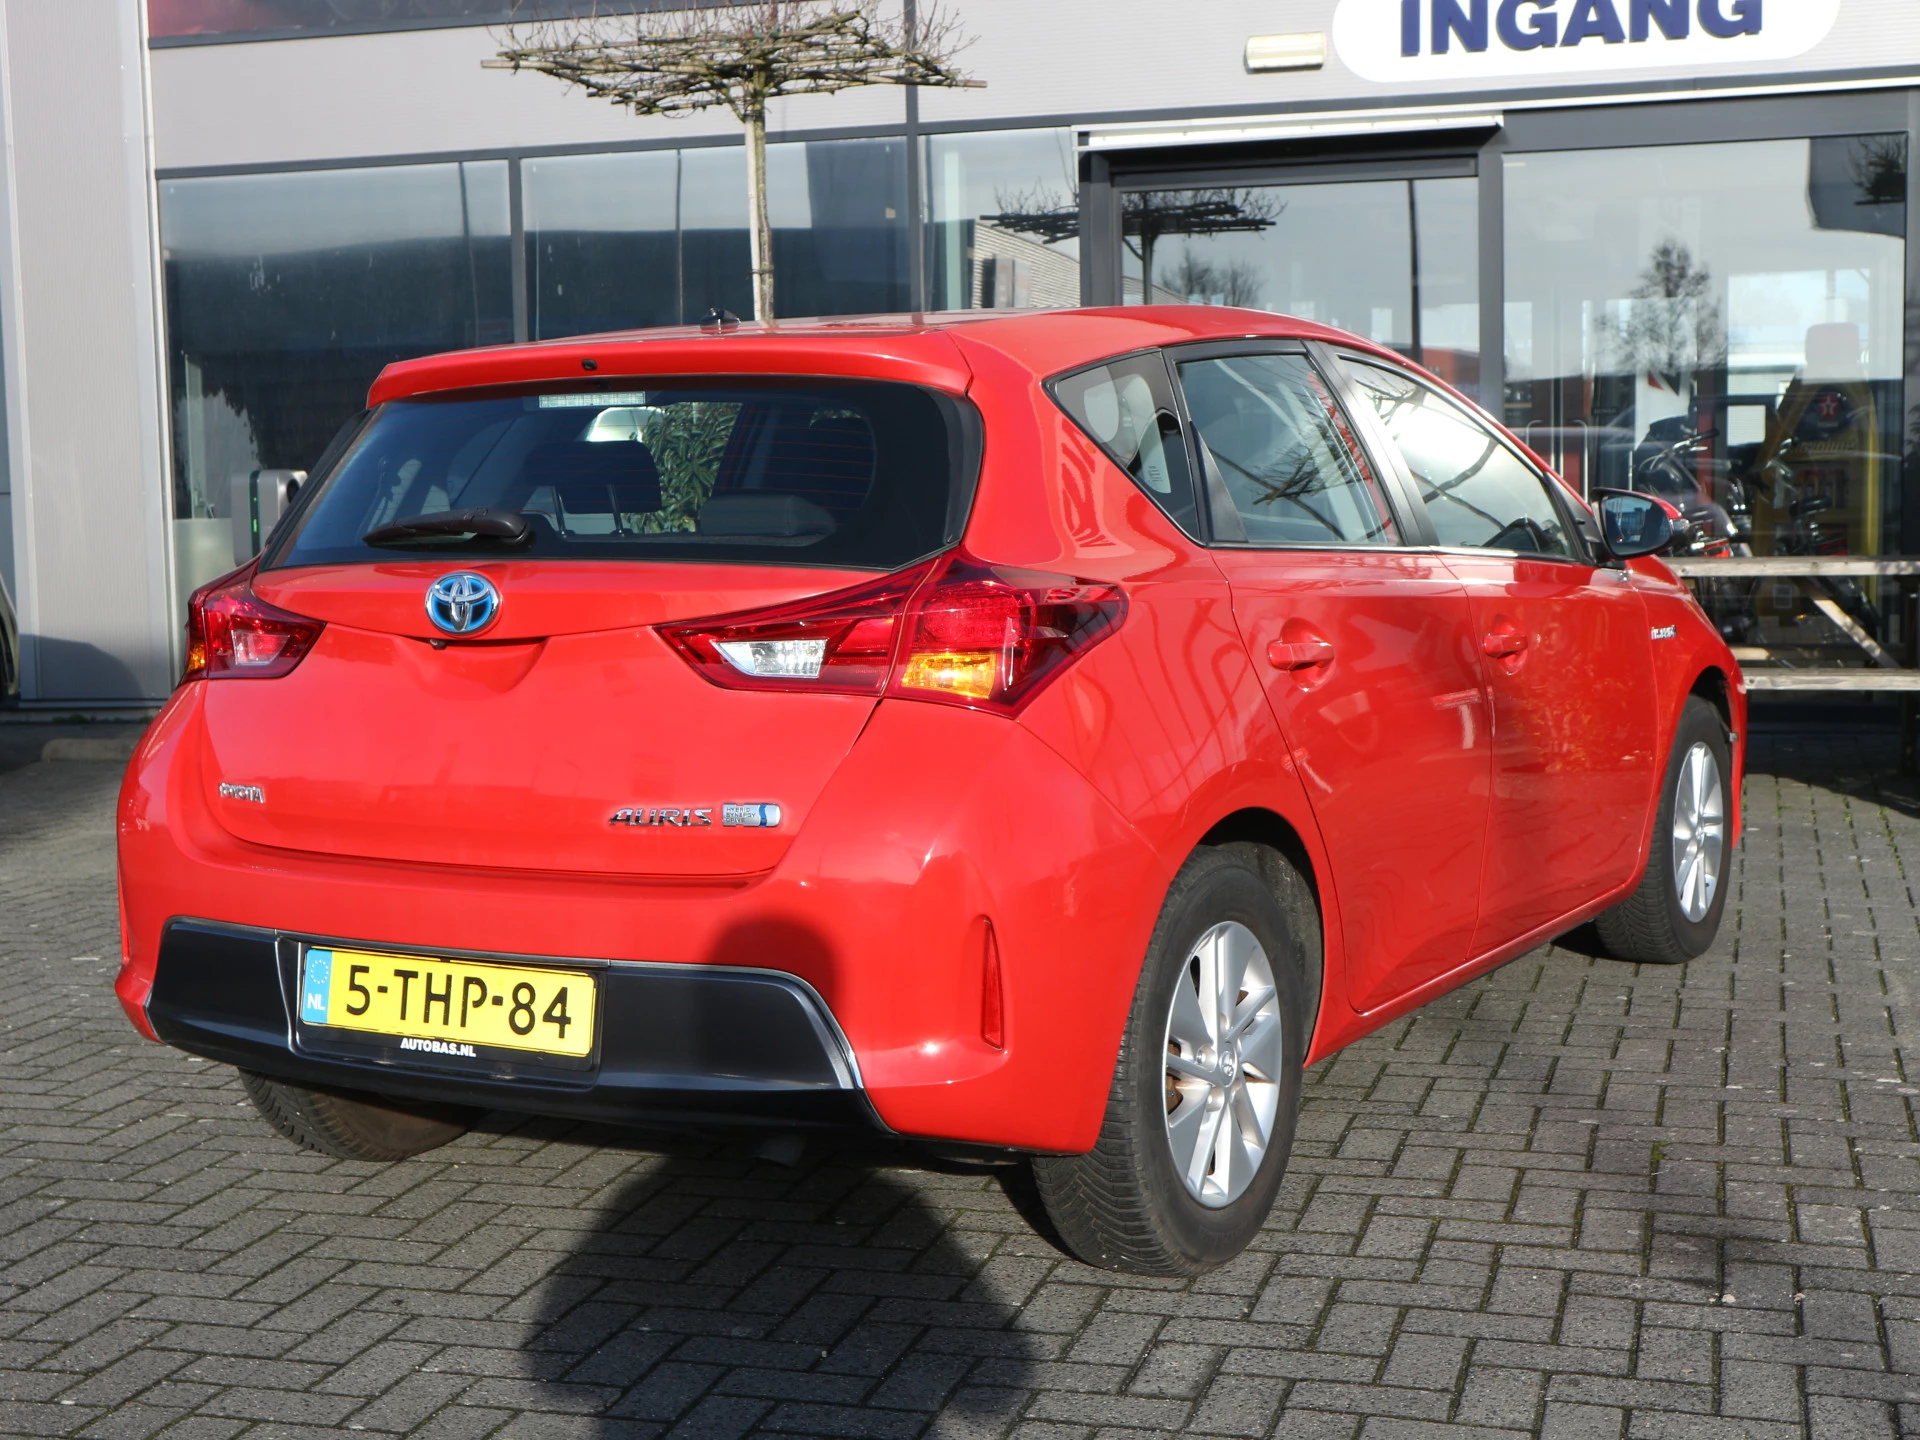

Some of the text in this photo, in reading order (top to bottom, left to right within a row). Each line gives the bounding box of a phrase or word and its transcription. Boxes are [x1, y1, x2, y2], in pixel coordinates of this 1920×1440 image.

[1400, 0, 1762, 57] INGANG
[608, 808, 712, 826] AURIS
[307, 992, 326, 1011] NL
[346, 964, 572, 1039] 5-THP-84
[400, 1037, 477, 1057] AUTOBAS.NL
